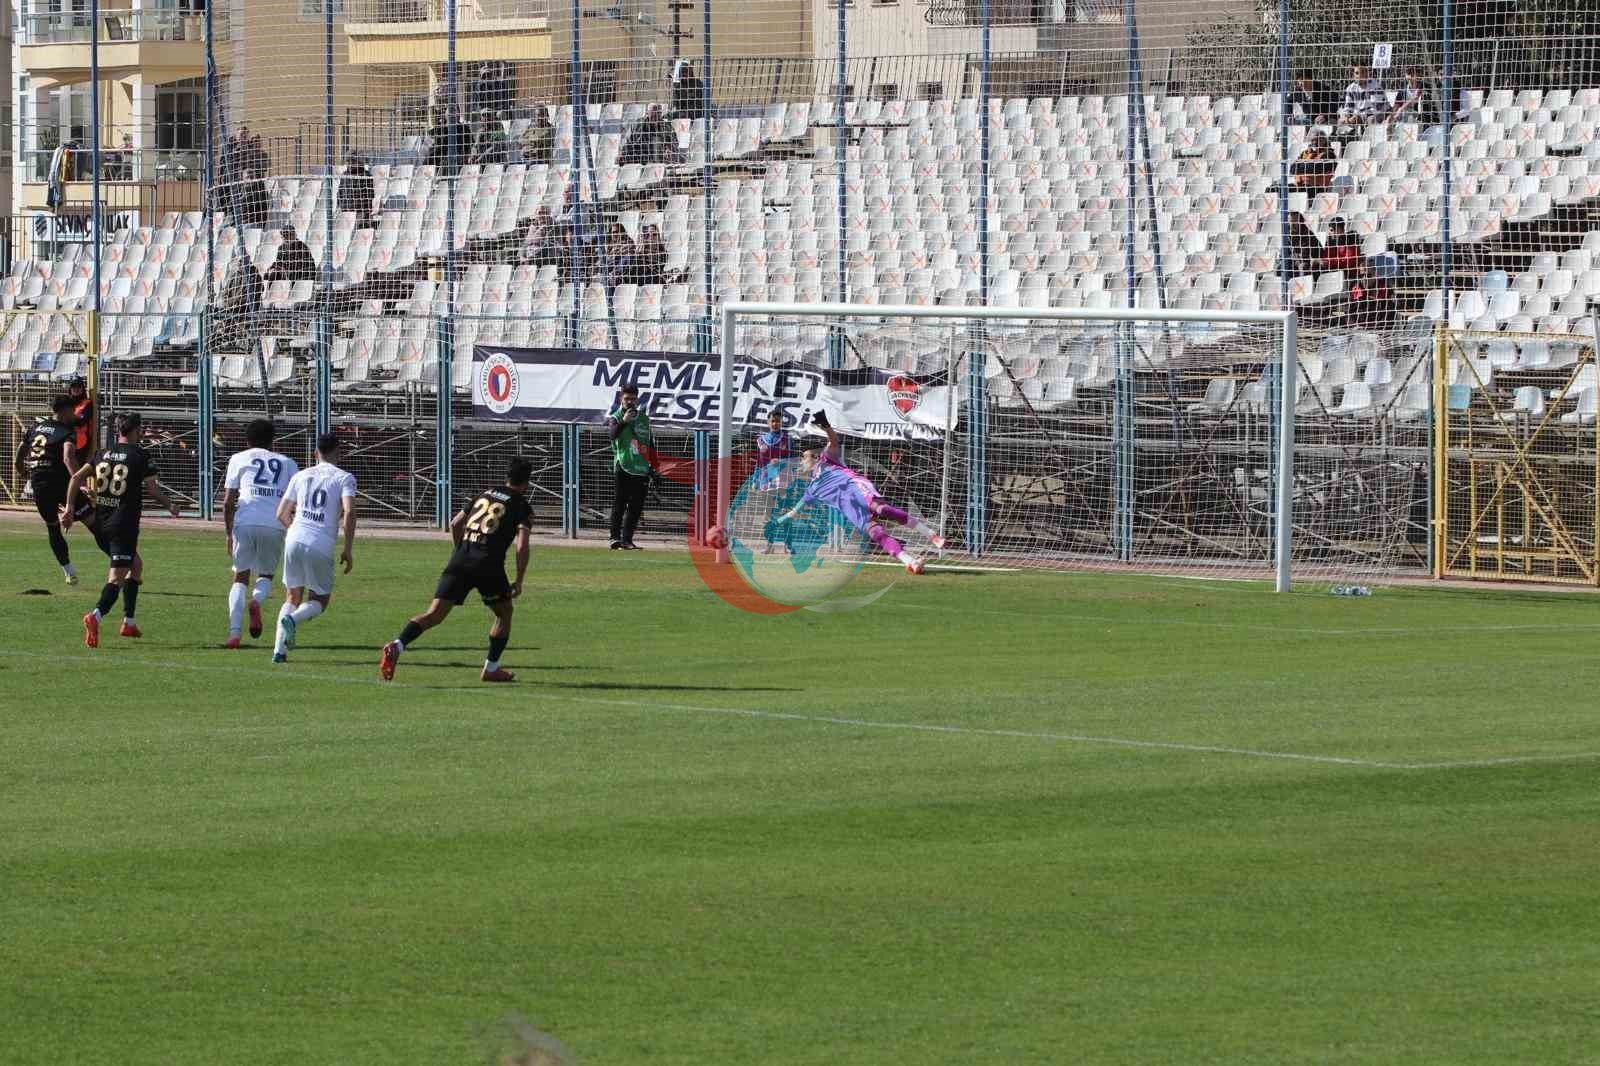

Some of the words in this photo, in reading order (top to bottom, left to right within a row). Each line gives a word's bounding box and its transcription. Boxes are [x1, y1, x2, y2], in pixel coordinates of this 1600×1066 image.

[95, 461, 129, 496] 88
[251, 458, 283, 484] 29
[466, 498, 506, 534] 28
